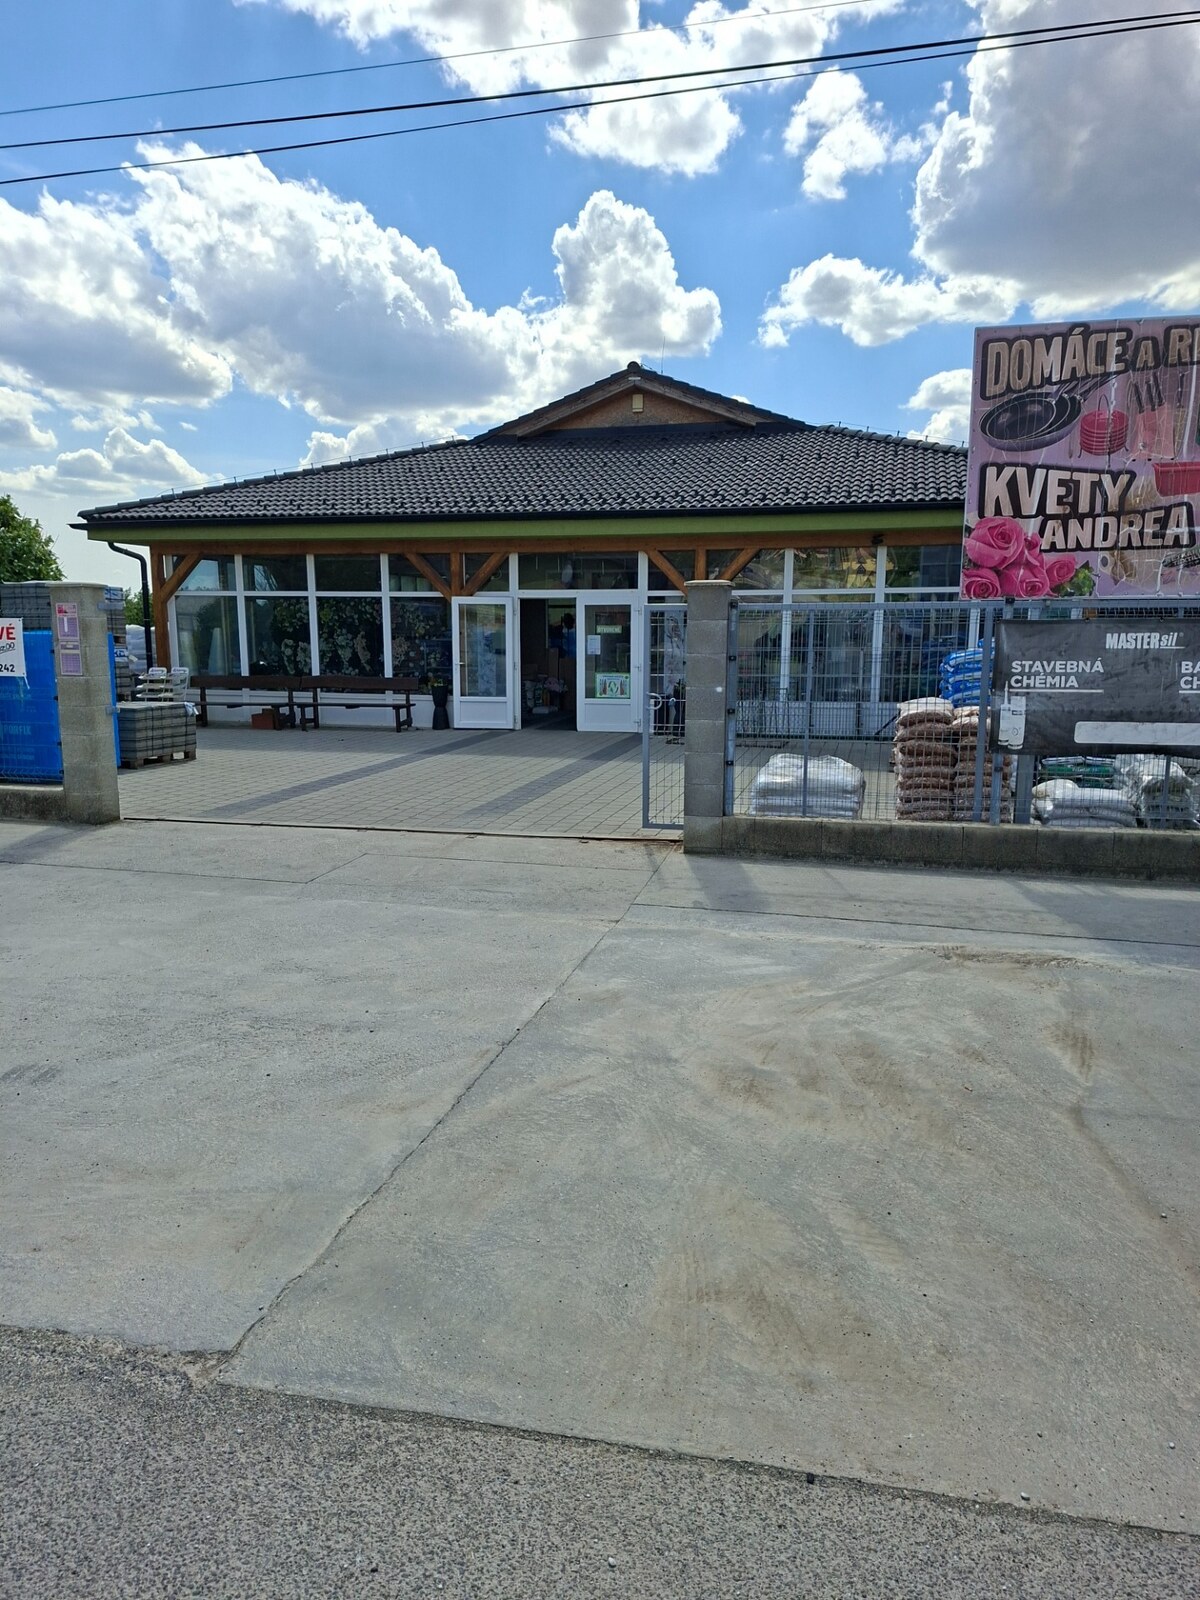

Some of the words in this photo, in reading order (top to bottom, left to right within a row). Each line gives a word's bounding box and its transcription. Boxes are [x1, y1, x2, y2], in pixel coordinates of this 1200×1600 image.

[984, 325, 1128, 398] DOMÁCE
[1135, 340, 1155, 369] A
[984, 466, 1131, 517] KVETY
[1041, 506, 1191, 550] ANDREA
[1010, 657, 1105, 674] STAVEBNÁ
[1010, 673, 1079, 688] CHÉMIA
